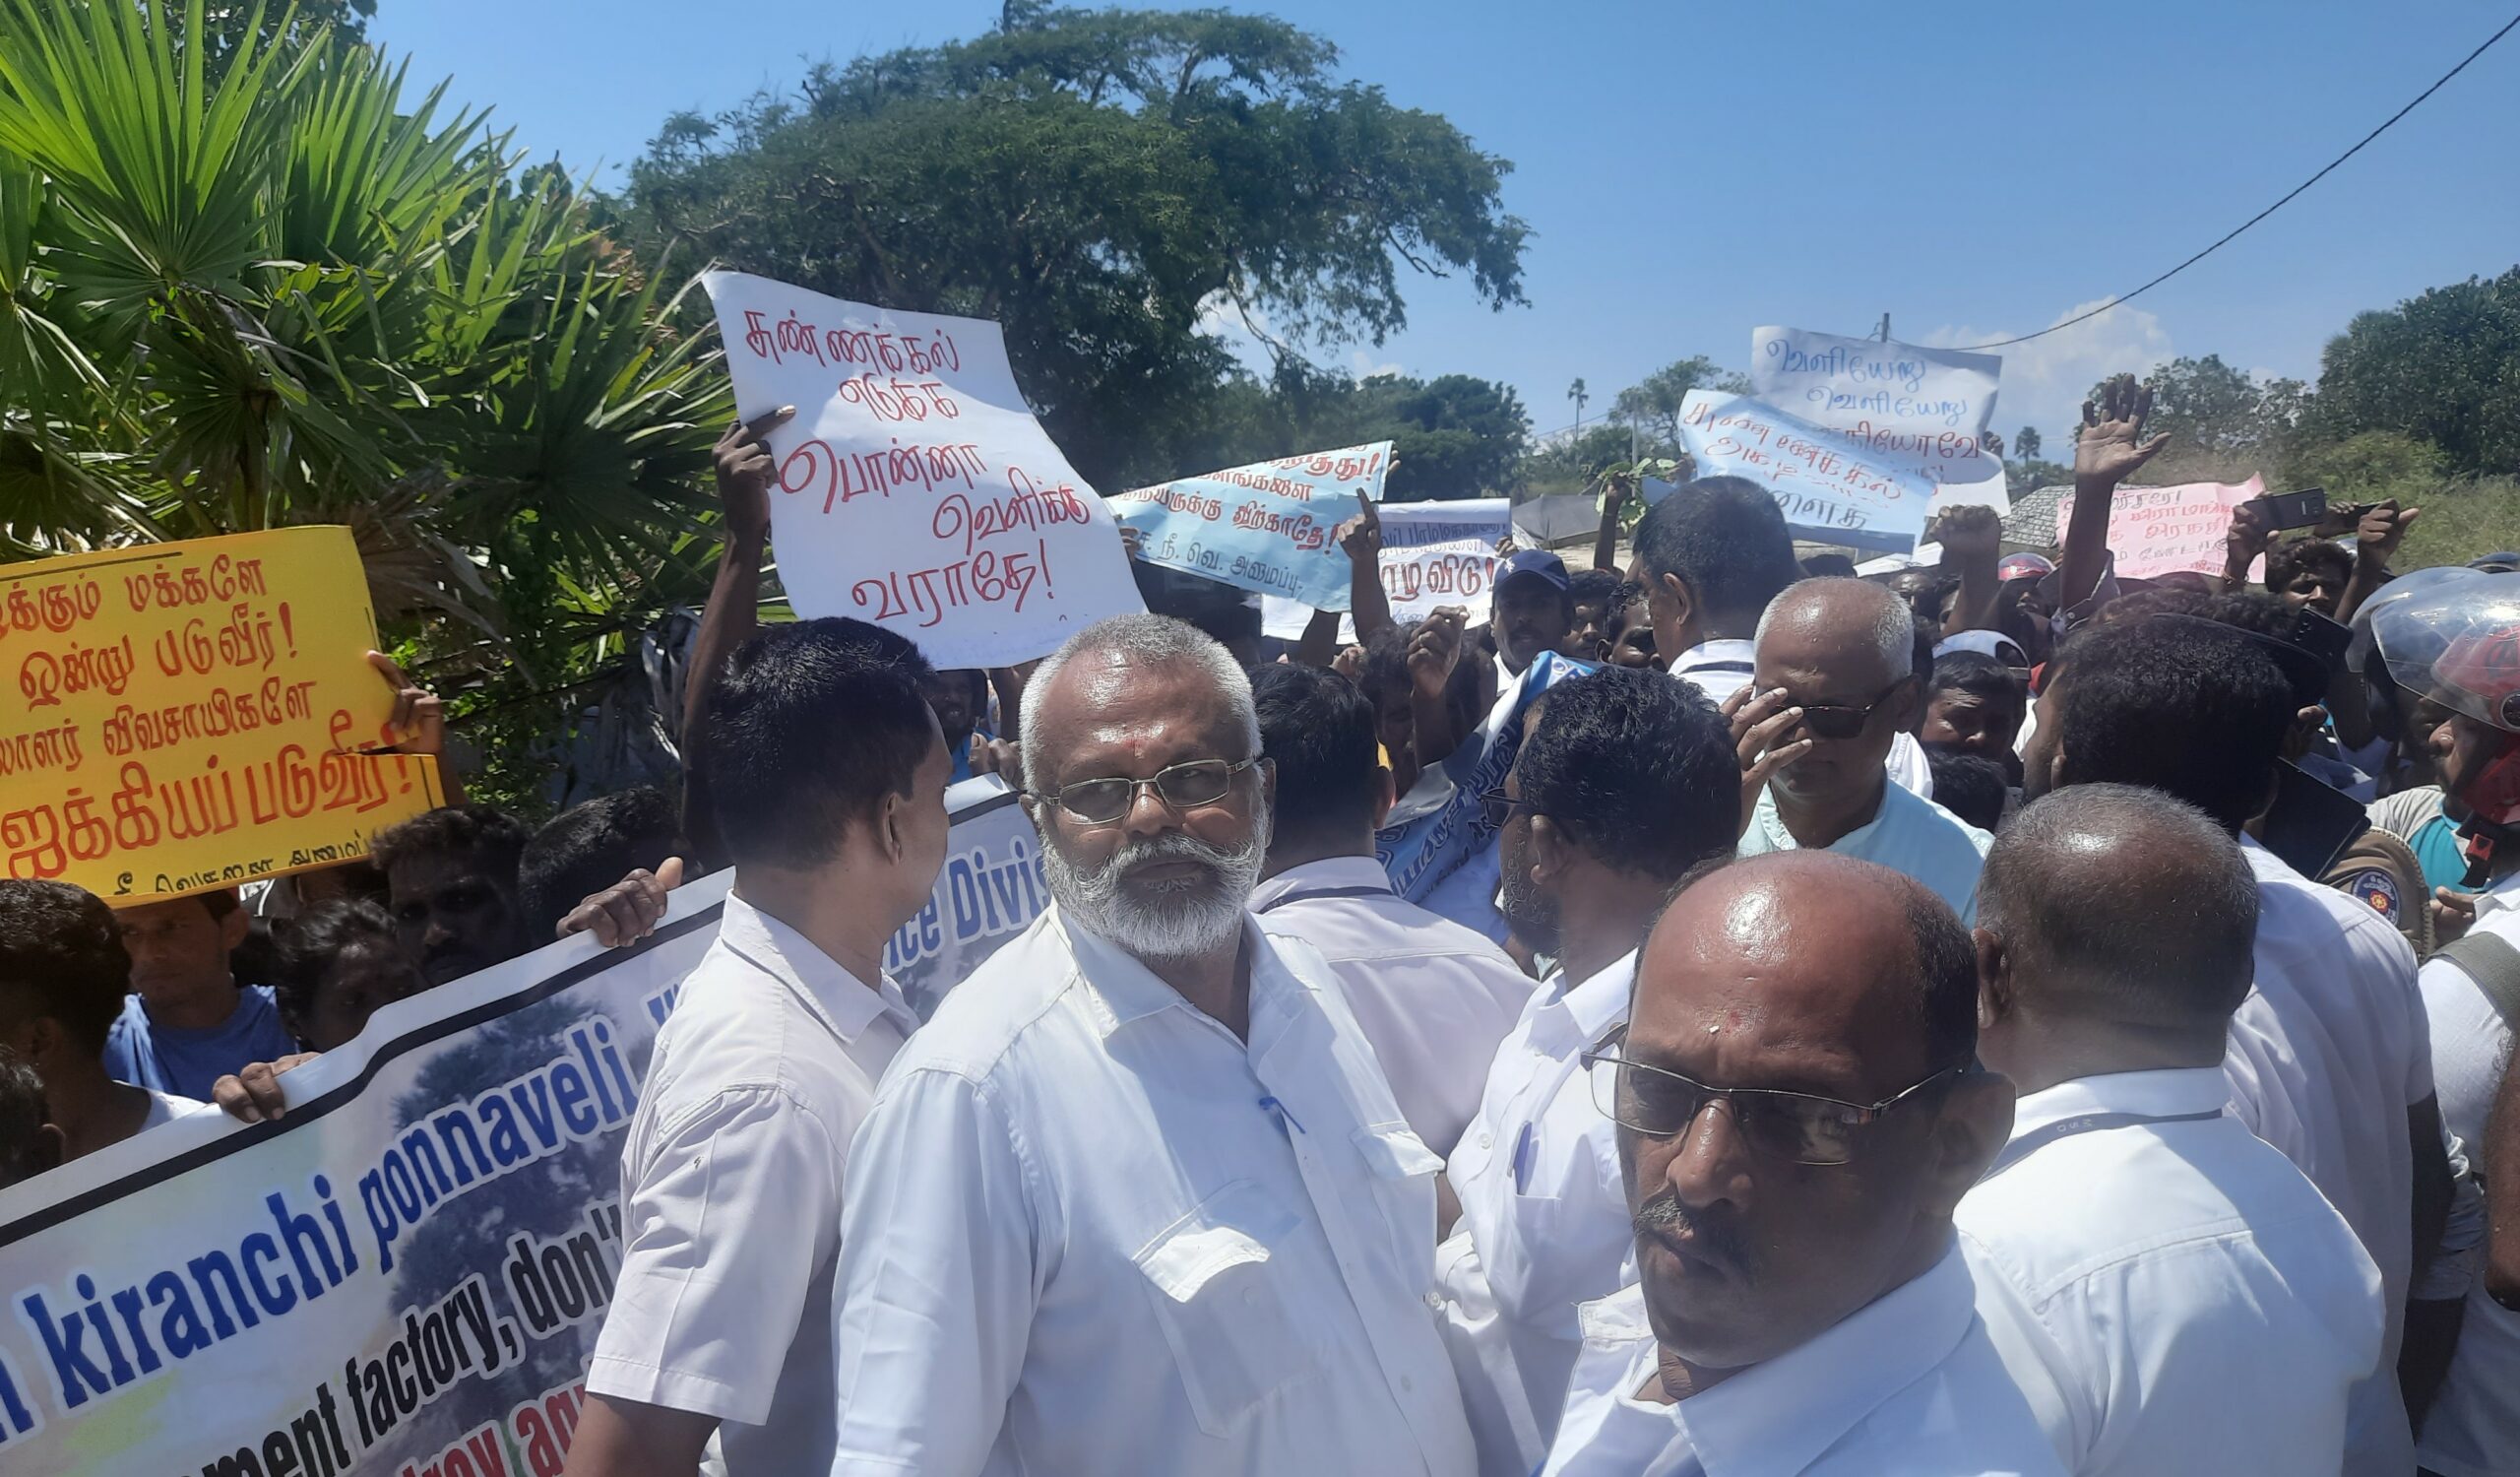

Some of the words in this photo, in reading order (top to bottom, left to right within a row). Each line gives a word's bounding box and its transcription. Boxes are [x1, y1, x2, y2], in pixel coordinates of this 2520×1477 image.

[125, 554, 268, 612] மக்களே
[851, 539, 1056, 627] வராதே!
[20, 634, 135, 712] ஒன்று
[102, 676, 318, 757] விவசாயிகளே
[24, 1174, 357, 1409] kiranchi
[345, 1281, 519, 1448] factory,
